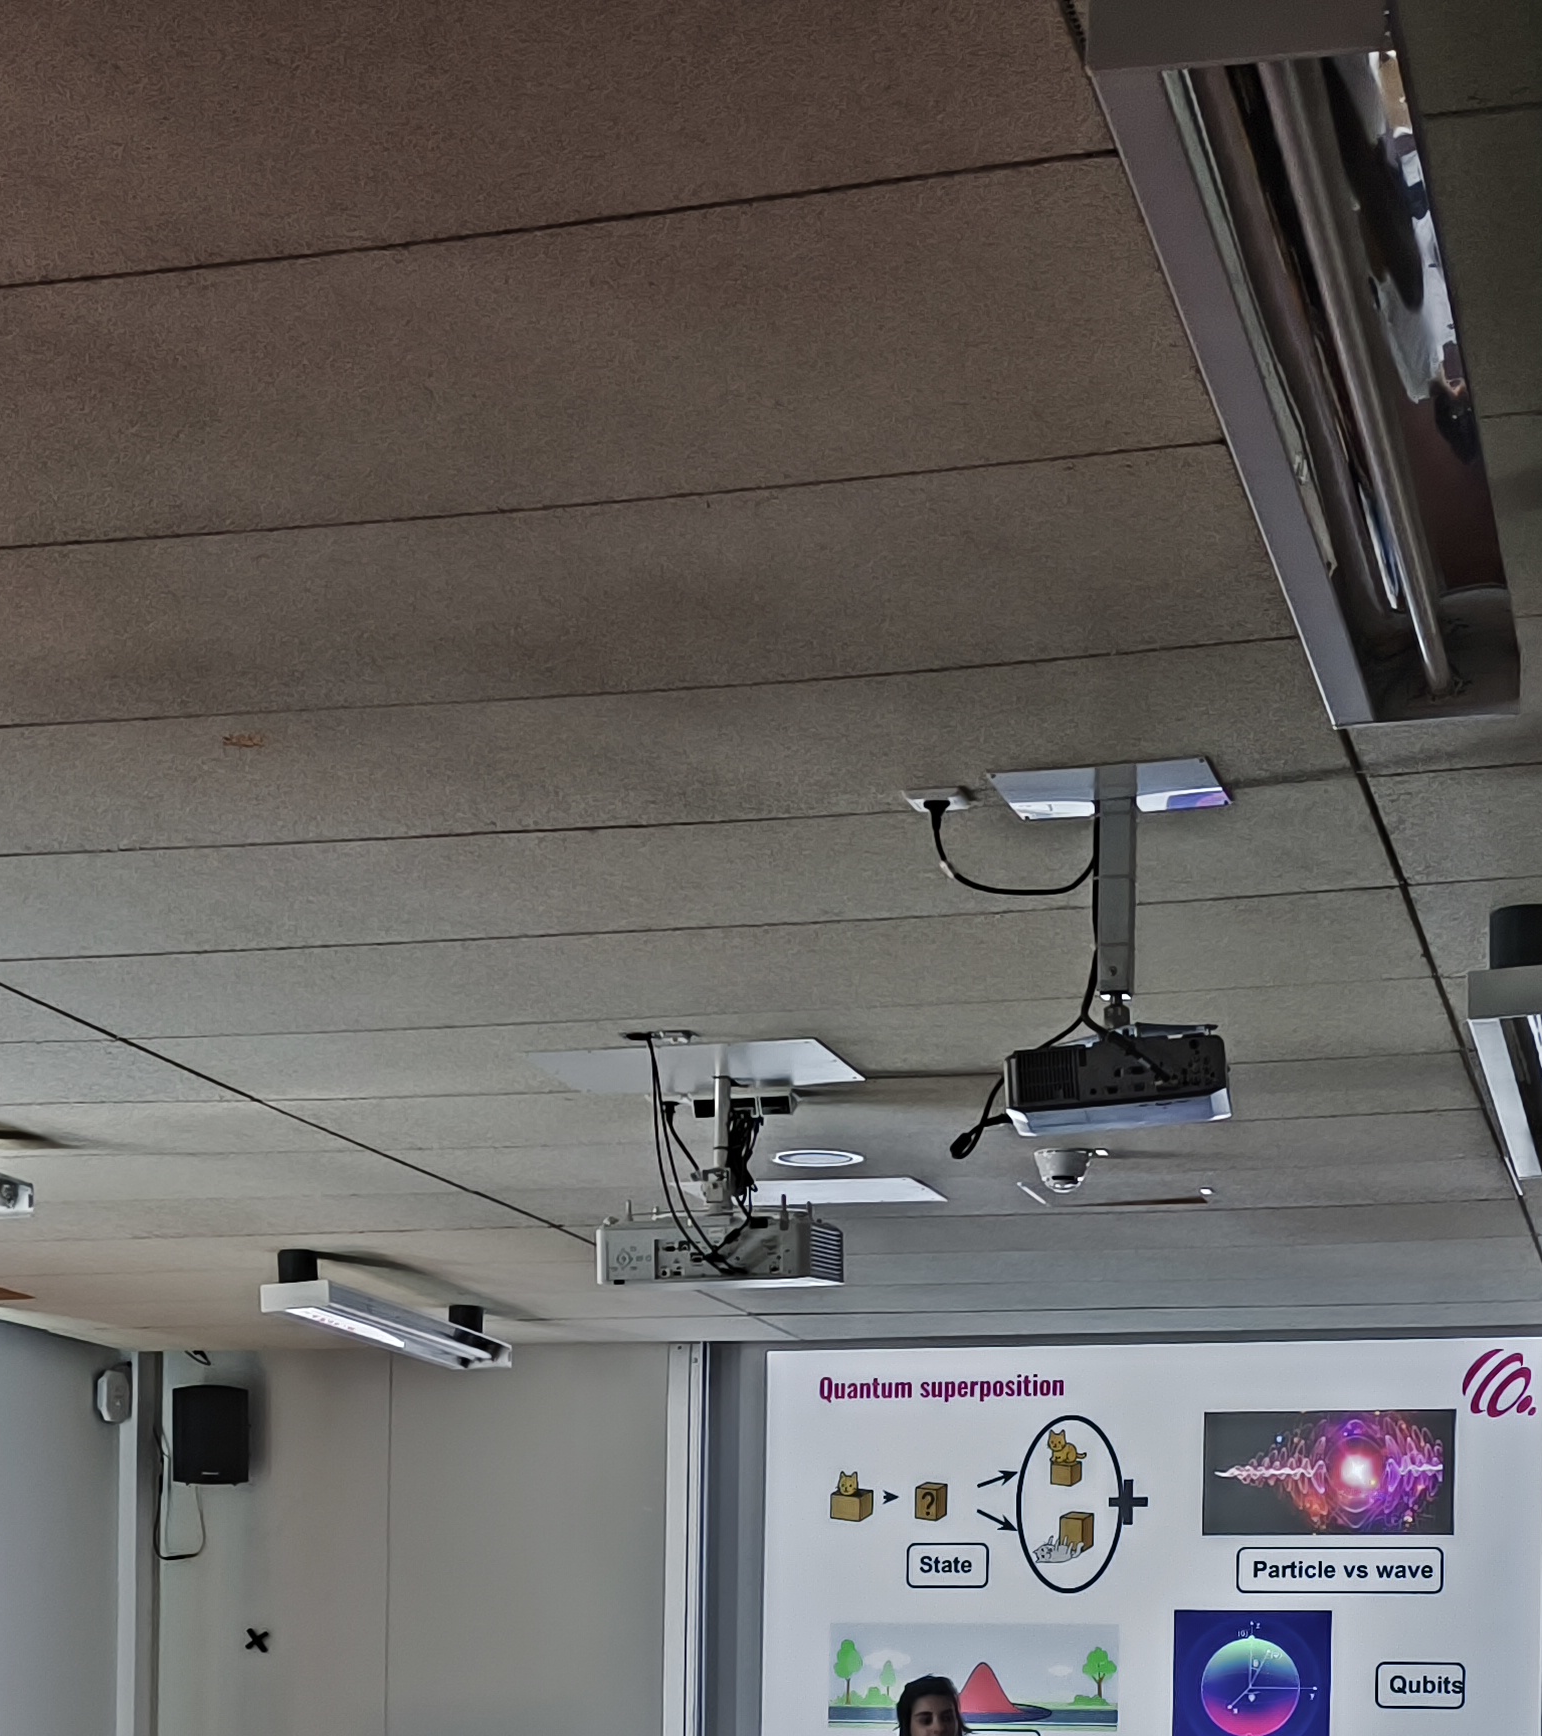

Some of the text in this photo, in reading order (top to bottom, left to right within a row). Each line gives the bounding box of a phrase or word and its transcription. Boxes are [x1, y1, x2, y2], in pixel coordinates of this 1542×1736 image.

[819, 1374, 1065, 1403] Quantum superposition
[919, 1555, 973, 1574] State
[1252, 1560, 1434, 1579] Particle vs wave
[1389, 1675, 1463, 1695] Qubits
